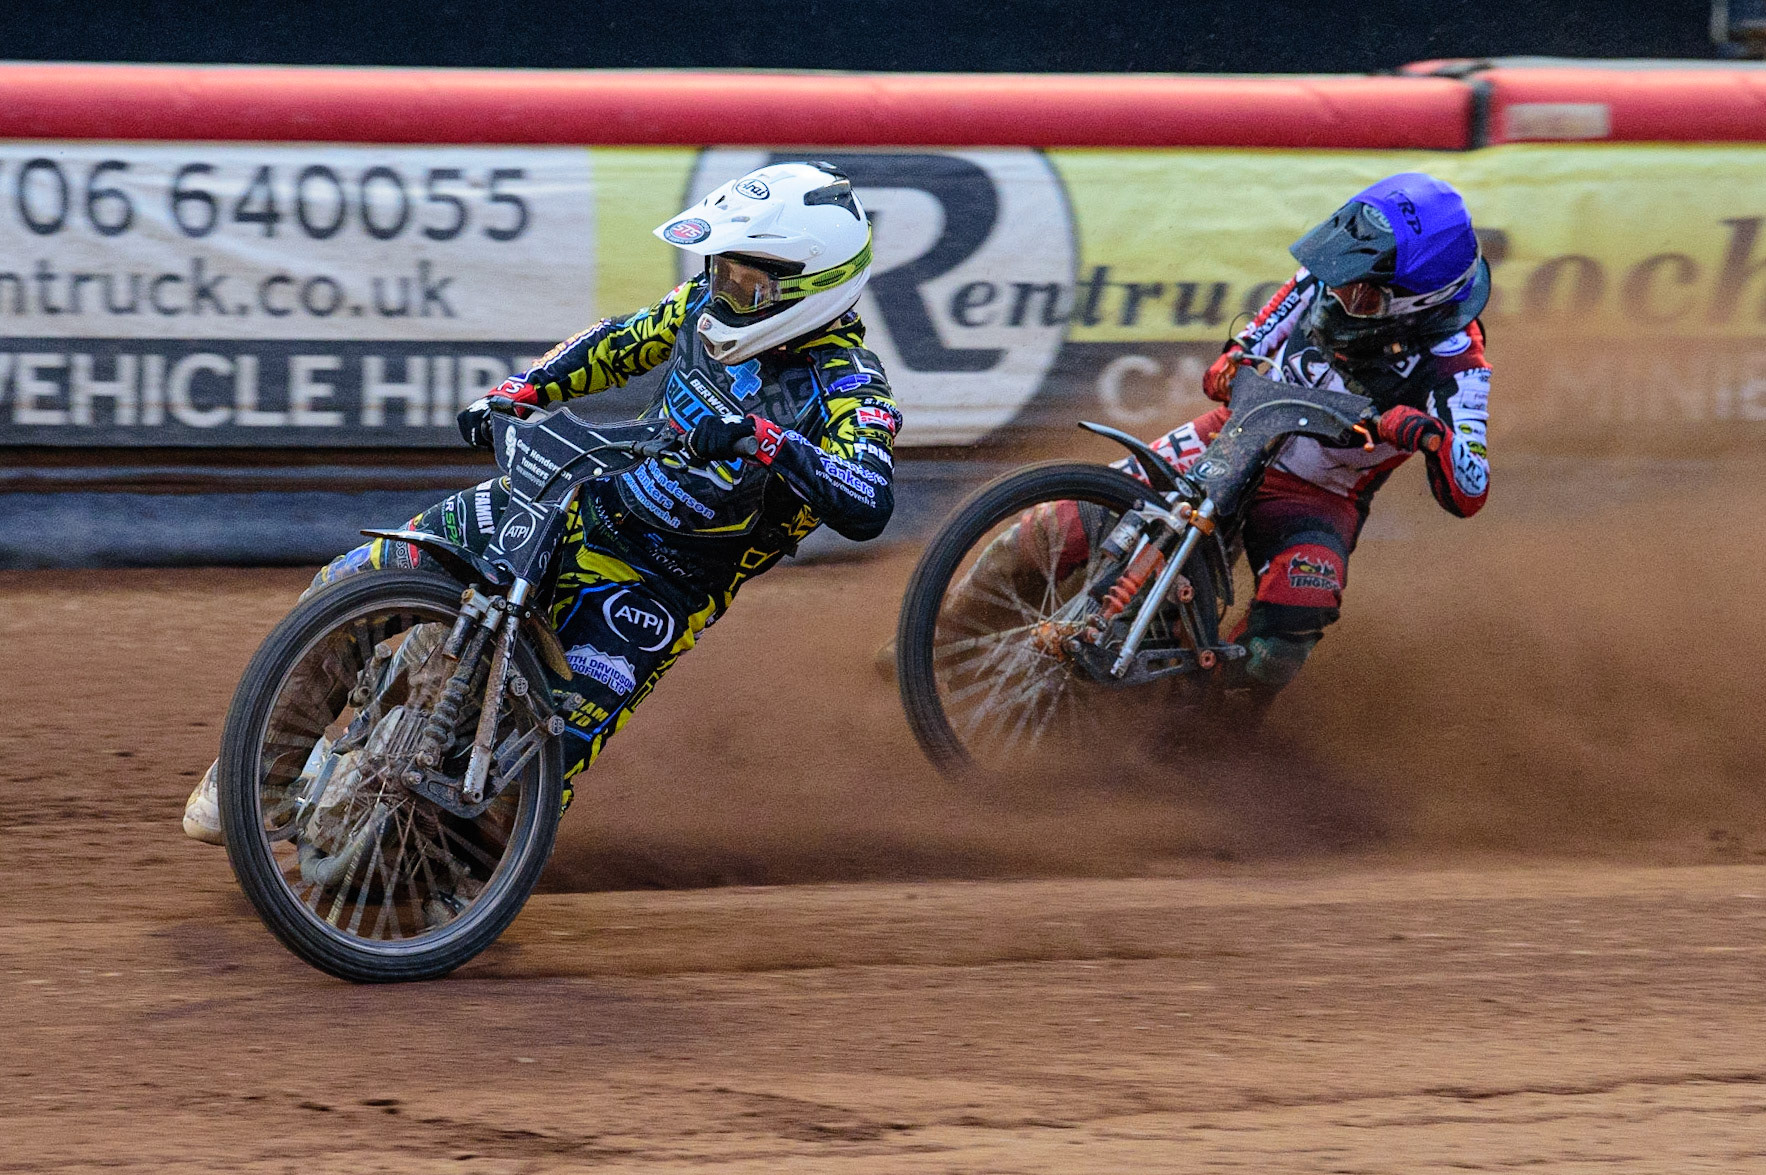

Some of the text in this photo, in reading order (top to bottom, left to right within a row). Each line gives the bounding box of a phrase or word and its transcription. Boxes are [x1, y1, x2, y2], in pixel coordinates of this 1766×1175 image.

[0, 157, 532, 241] 06 640055
[530, 448, 574, 482] Henderon
[819, 456, 876, 499] Tankers
[633, 463, 675, 510] Tankers
[648, 457, 716, 520] Henderson
[504, 524, 531, 540] ATPI
[614, 604, 664, 636] ATPI
[570, 663, 626, 696] OOFING LTD
[588, 658, 635, 692] DAVIDSON
